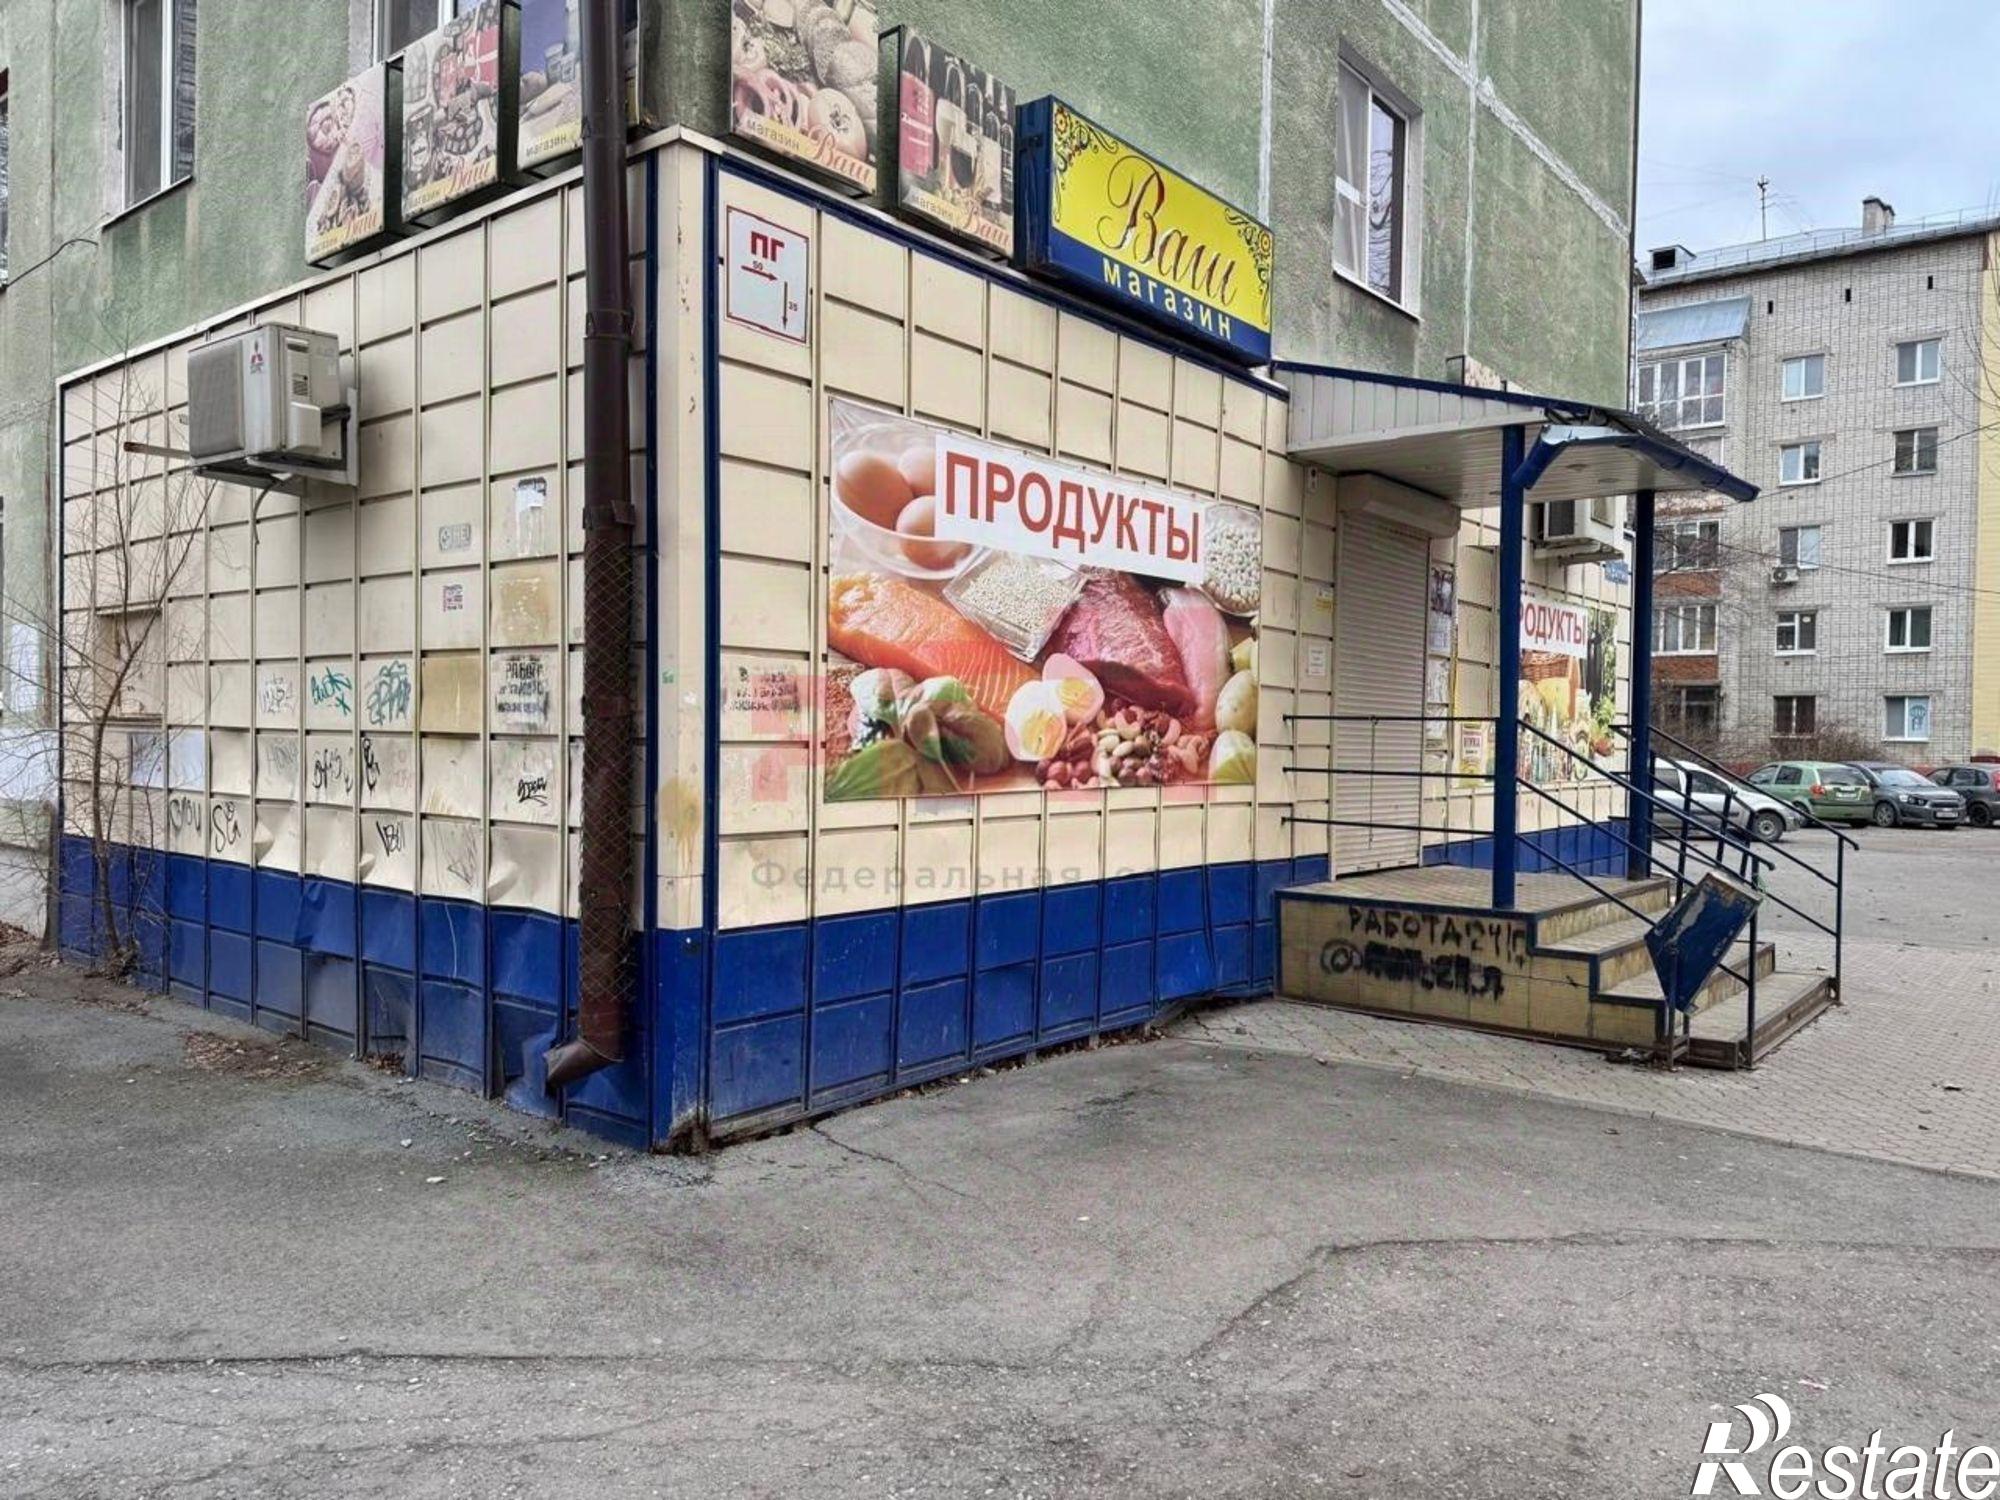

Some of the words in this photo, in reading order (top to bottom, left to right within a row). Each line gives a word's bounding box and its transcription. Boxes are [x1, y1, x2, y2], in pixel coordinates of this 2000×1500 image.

[750, 230, 785, 263] ПГ
[1097, 154, 1239, 306] Ваш
[1103, 257, 1232, 341] магазин
[944, 451, 1200, 564] ПРОДУКТЫ
